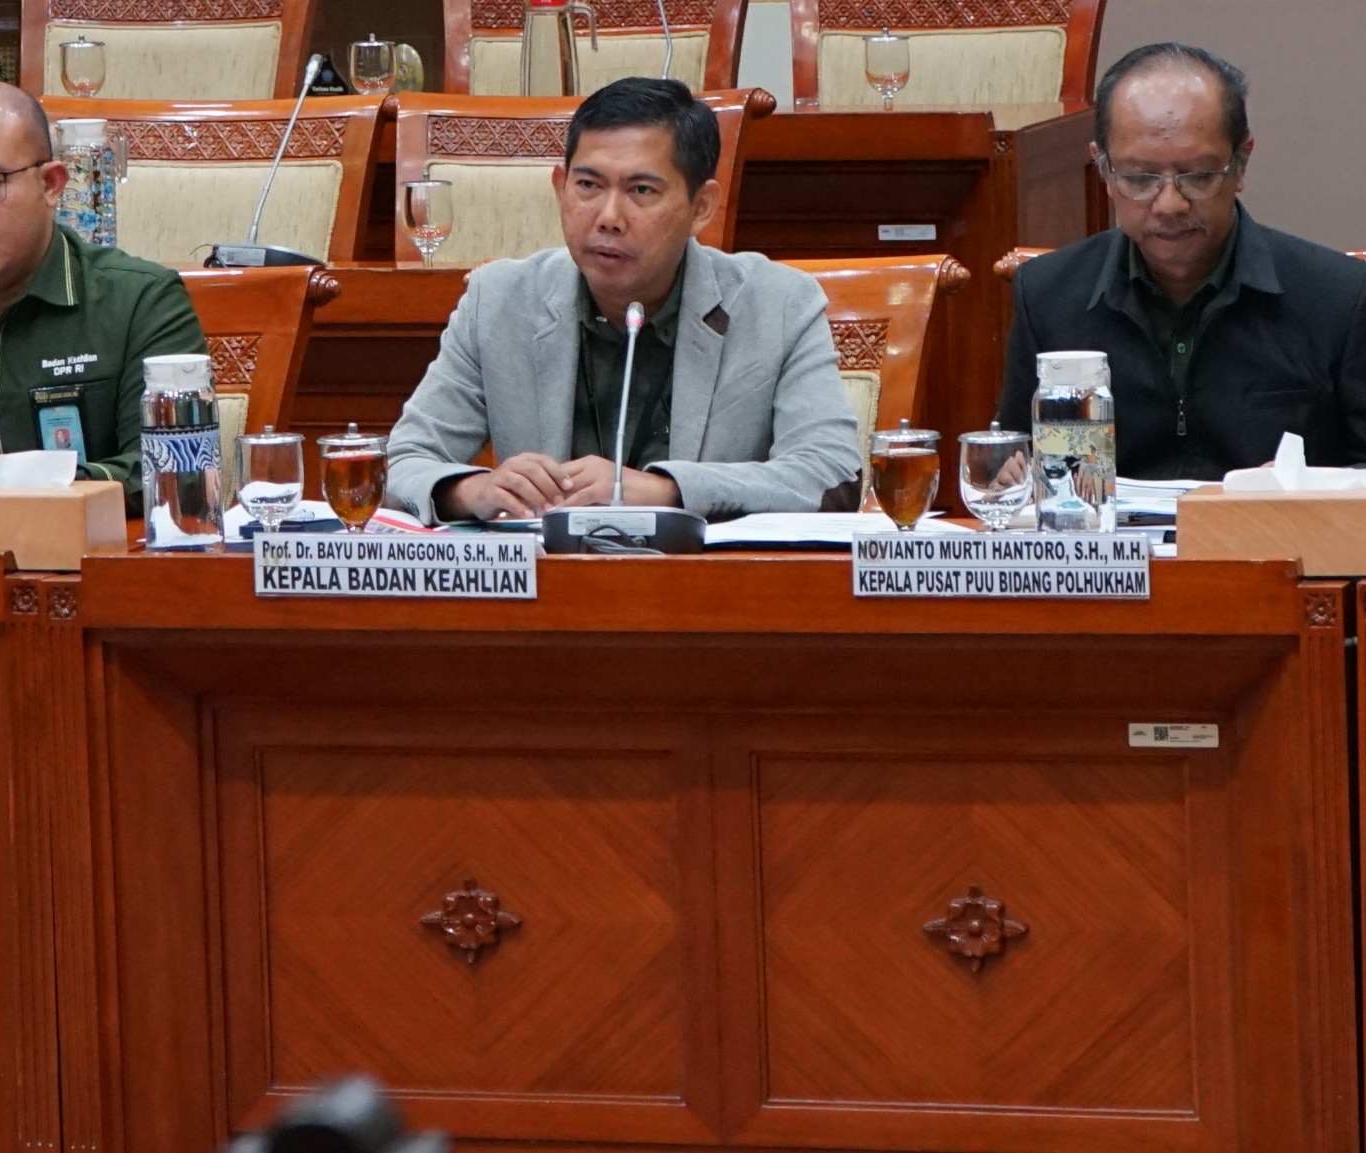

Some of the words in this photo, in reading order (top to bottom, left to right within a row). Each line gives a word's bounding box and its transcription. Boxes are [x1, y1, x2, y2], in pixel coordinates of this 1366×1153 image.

[41, 359, 66, 368] Badan
[67, 353, 98, 365] Keahlian
[53, 365, 72, 376] DPR
[75, 364, 84, 373] RI
[262, 540, 291, 560] Prof.
[296, 541, 313, 559] Dr.
[317, 541, 353, 560] BAYU
[358, 542, 383, 561] DWI
[387, 543, 459, 566] ANGGONO,
[464, 544, 494, 566] S.H.,
[498, 544, 527, 563] M.H.
[858, 540, 934, 560] NOVIANTO
[939, 540, 986, 560] MURTI
[992, 541, 1069, 565] HANTORO,
[1074, 541, 1108, 565] S.H.,
[1113, 541, 1145, 561] M.H.
[262, 566, 339, 590] KEPALA
[348, 567, 416, 592] BADAN
[423, 569, 528, 594] KEAHLIAN
[859, 570, 912, 593] KEPALA
[917, 570, 961, 593] PUSAT
[966, 570, 994, 593] PUU
[999, 570, 1052, 593] BIDANG
[1056, 570, 1146, 594] POLHUKHAM
